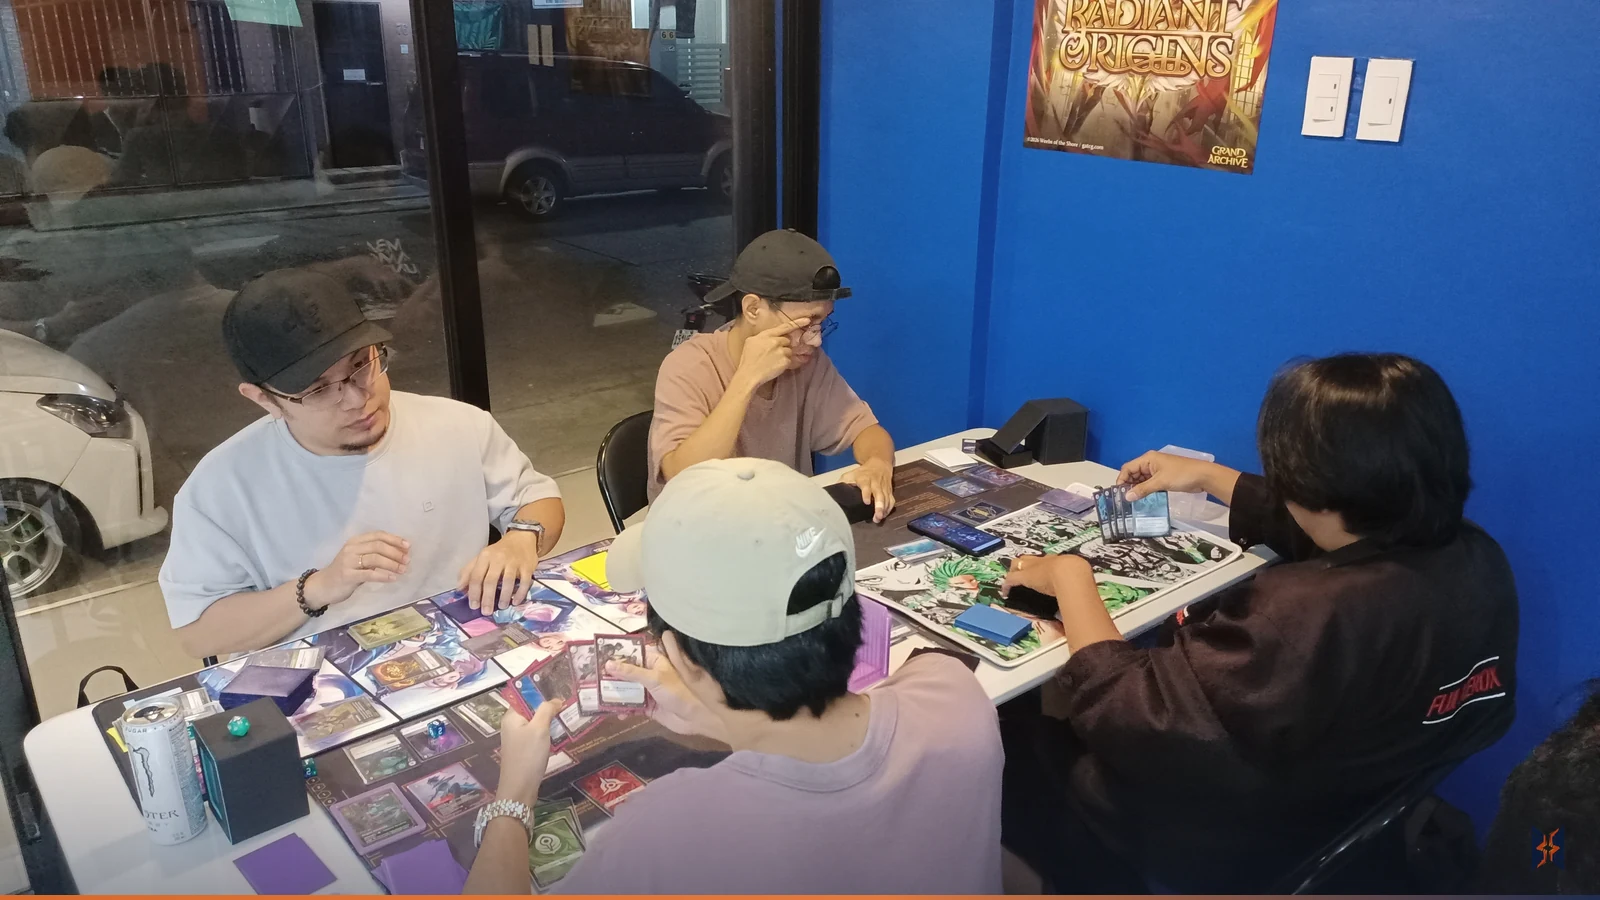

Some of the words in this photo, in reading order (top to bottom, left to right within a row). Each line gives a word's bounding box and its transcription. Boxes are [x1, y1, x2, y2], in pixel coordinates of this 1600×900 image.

[1062, 0, 1242, 34] RADIANT
[661, 31, 674, 39] 66
[1059, 32, 1234, 78] ORIGINS
[1211, 145, 1246, 158] GRAND
[1207, 154, 1249, 168] ARCHIVE
[796, 526, 815, 549] NIKE
